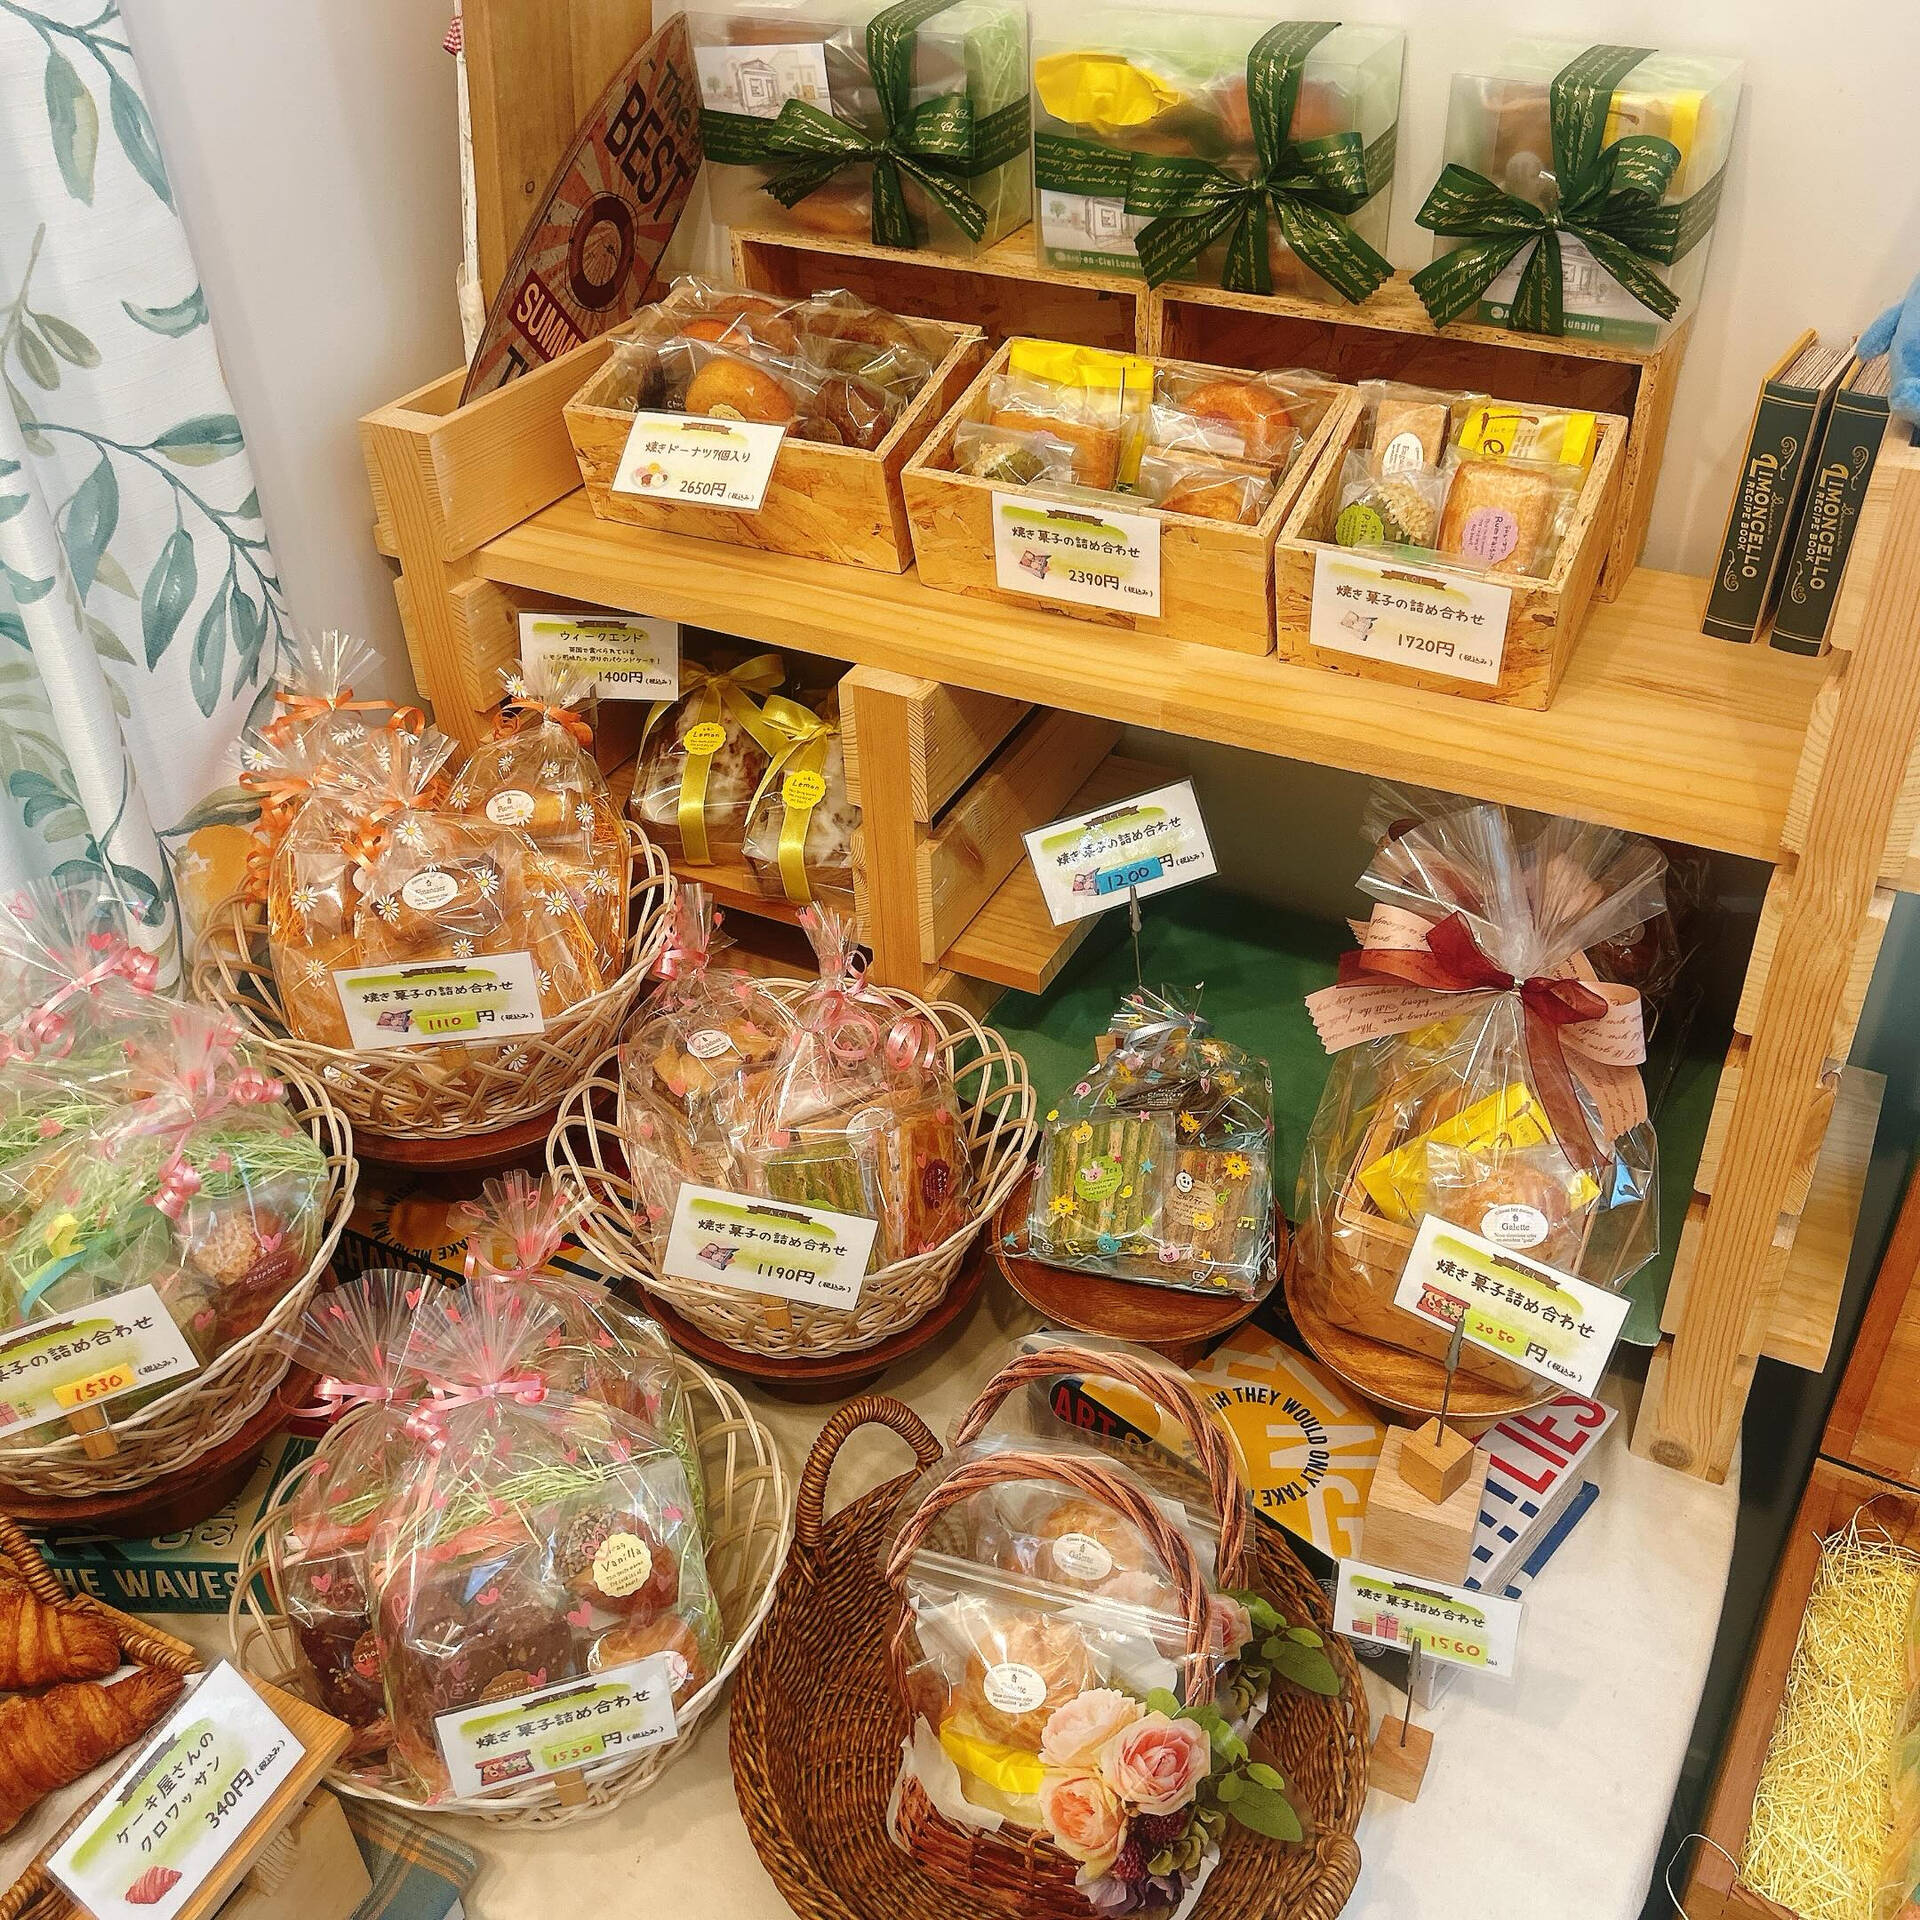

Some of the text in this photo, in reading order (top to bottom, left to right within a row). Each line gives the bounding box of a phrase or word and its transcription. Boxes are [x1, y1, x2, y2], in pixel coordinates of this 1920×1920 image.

[604, 79, 690, 222] BEST
[1563, 318, 1600, 332] Lunaire
[645, 441, 751, 464] 焼きドーナツ7個入り
[679, 479, 727, 499] 2650円
[1737, 480, 1754, 551] RECIPE BOOK
[1741, 452, 1779, 579] LIMONCELLO
[1804, 490, 1826, 562] RECIPE BOOK
[1809, 463, 1849, 591] LIMONCELLO
[1011, 524, 1141, 559] 焼き菓子の詰め合わせ
[1068, 567, 1154, 598] 2390円 (税込み)
[1336, 584, 1485, 626] 焼き菓子の詰め合わせ
[560, 630, 644, 643] ウィークエンド
[1397, 633, 1494, 667] 1720円 (税込み)
[598, 671, 644, 684] 1400円
[692, 730, 720, 740] Lemon
[791, 778, 820, 791] Lemon
[1108, 866, 1150, 891] 1200
[1159, 853, 1174, 869] 円
[362, 980, 514, 1004] 焼き菓子の詰め合わせ
[427, 1009, 535, 1031] 1110 円 (税込み)
[697, 1218, 848, 1257] 焼き菓子の詰め合わせ
[1501, 1222, 1530, 1231] Galette
[437, 1239, 468, 1261] AKE
[755, 1262, 852, 1293] 1190円 (税込み)
[1435, 1258, 1596, 1340] 焼き菓子詰め合わせ
[74, 1357, 178, 1402] 1530 (税込み)
[1525, 1341, 1548, 1364] 円
[1547, 1359, 1583, 1382] (税込み)
[1054, 1386, 1117, 1441] ART
[1233, 1386, 1331, 1508] THEY WOULD ONLY TAKE
[1489, 1394, 1607, 1496] LIES
[600, 1546, 642, 1573] Vanilla
[53, 1568, 240, 1600] HE WAVES
[1356, 1587, 1485, 1629] 焼き菓子詰め合わせ
[1430, 1635, 1480, 1657] 1560
[476, 1688, 651, 1749] 焼き菓子詰め合わせ
[552, 1725, 664, 1764] 1530 円 (税込み)
[116, 1731, 215, 1847] ケーキ屋さんの
[205, 1739, 286, 1830] 340円 (税込み)
[141, 1756, 222, 1853] クロワッサン
